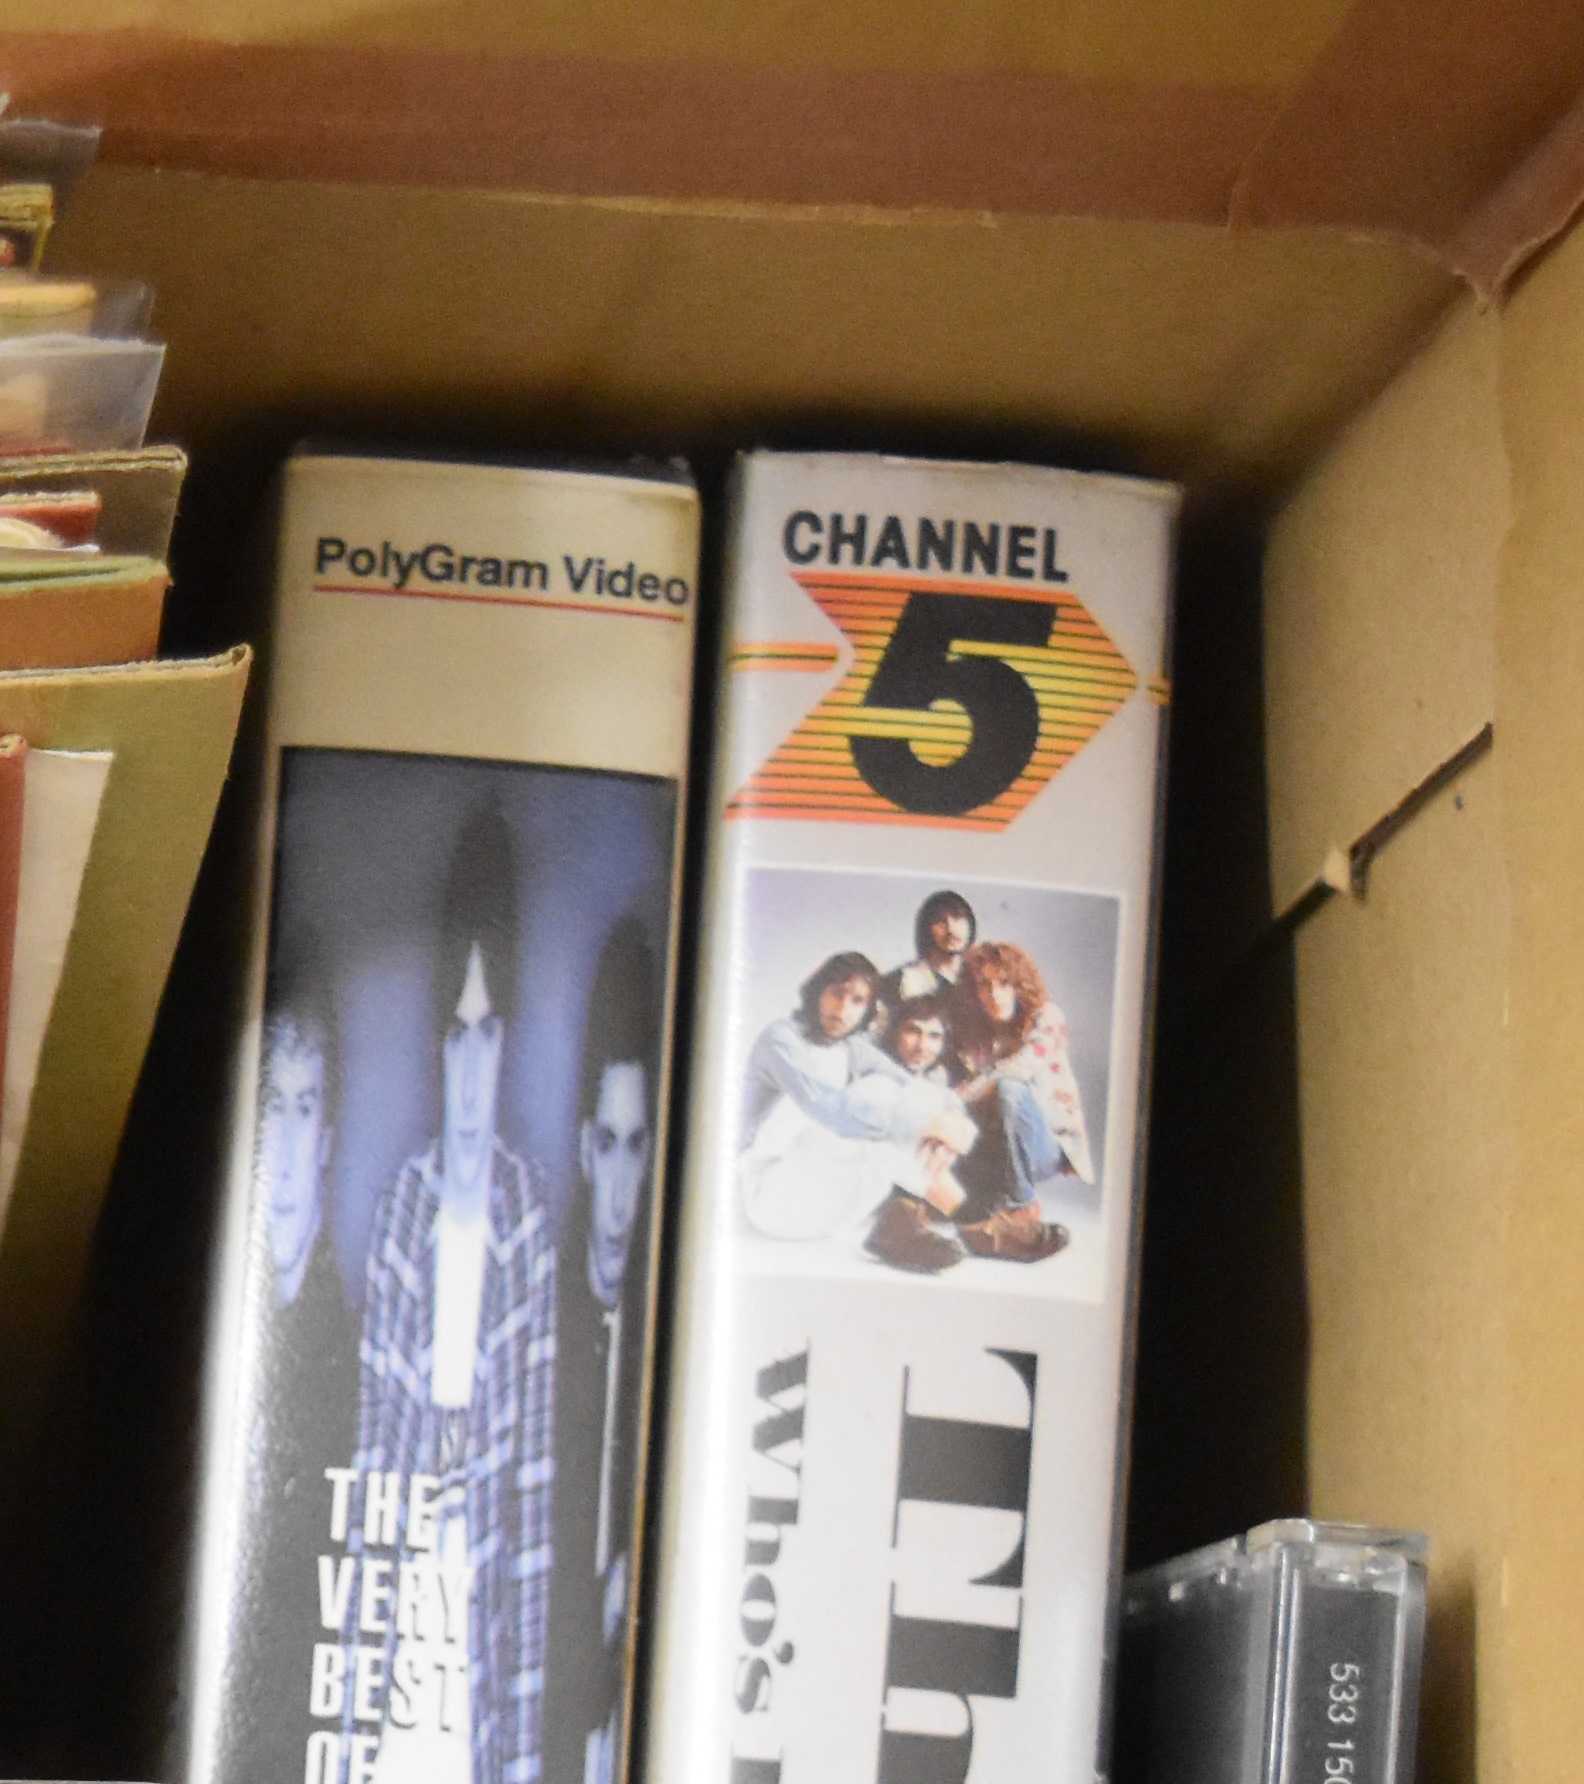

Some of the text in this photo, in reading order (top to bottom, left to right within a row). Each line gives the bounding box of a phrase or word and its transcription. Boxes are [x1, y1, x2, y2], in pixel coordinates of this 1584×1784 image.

[314, 536, 690, 606] PolyGram Video
[782, 509, 1071, 584] CHANNEL
[845, 590, 1059, 818] 5
[324, 1466, 441, 1549] THE
[730, 1336, 812, 1716] Who's
[316, 1555, 476, 1648] VERY
[309, 1642, 471, 1733] BEST
[1326, 1661, 1361, 1726] 533
